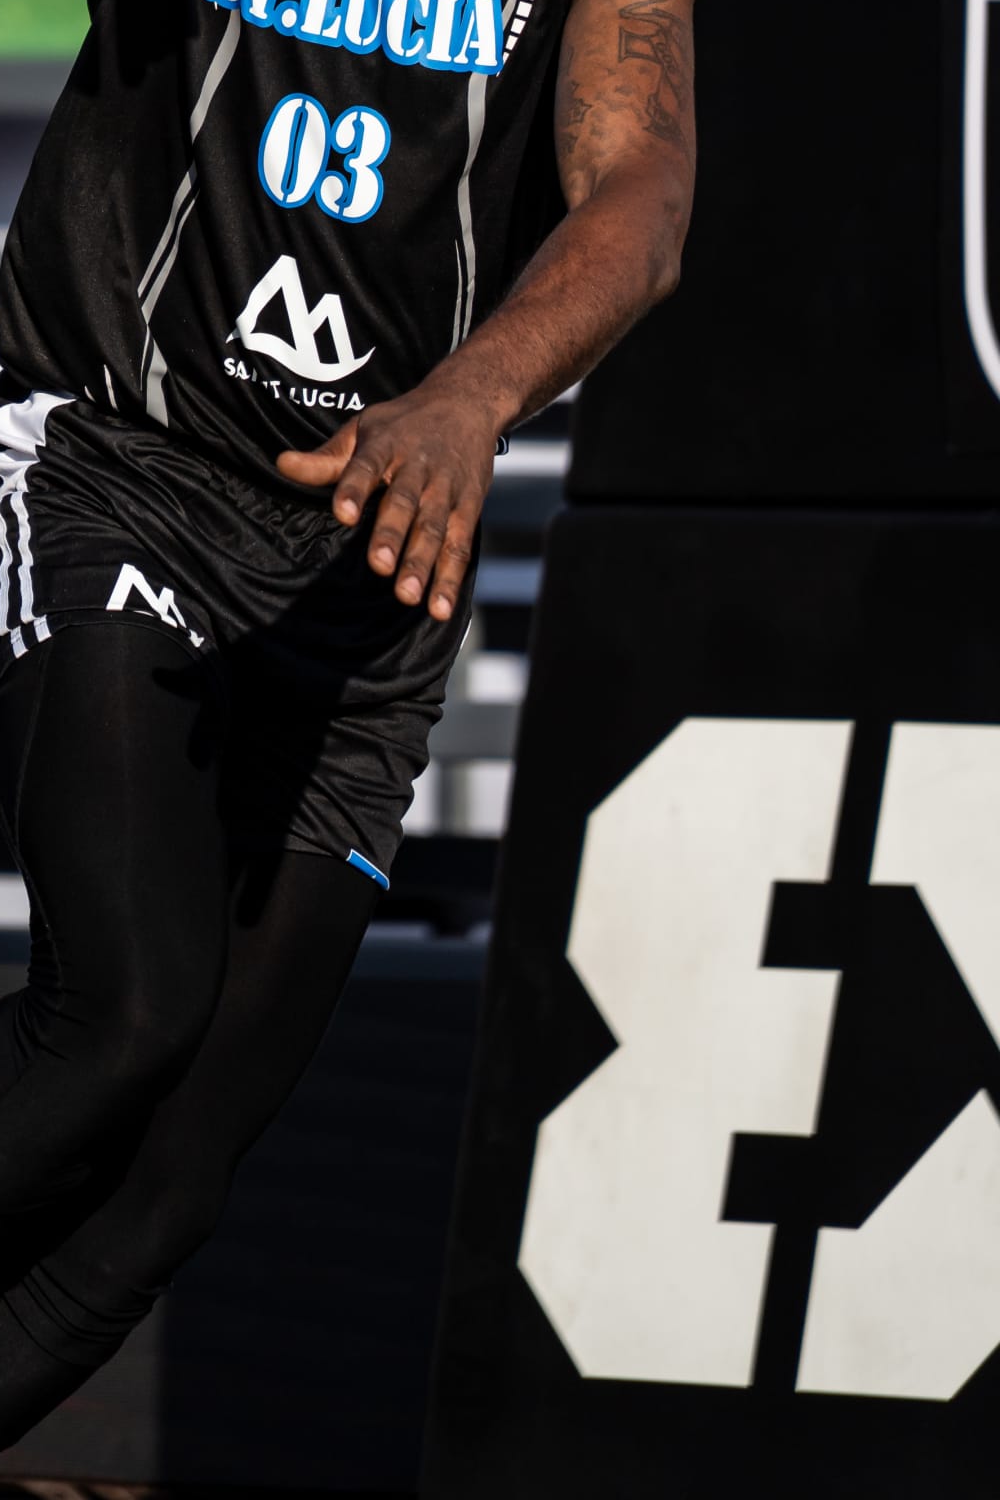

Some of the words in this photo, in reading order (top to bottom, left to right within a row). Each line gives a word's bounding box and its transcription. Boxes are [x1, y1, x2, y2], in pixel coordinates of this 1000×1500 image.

[259, 93, 391, 223] 03
[223, 357, 281, 399] SAIT
[289, 387, 366, 411] LUCIA
